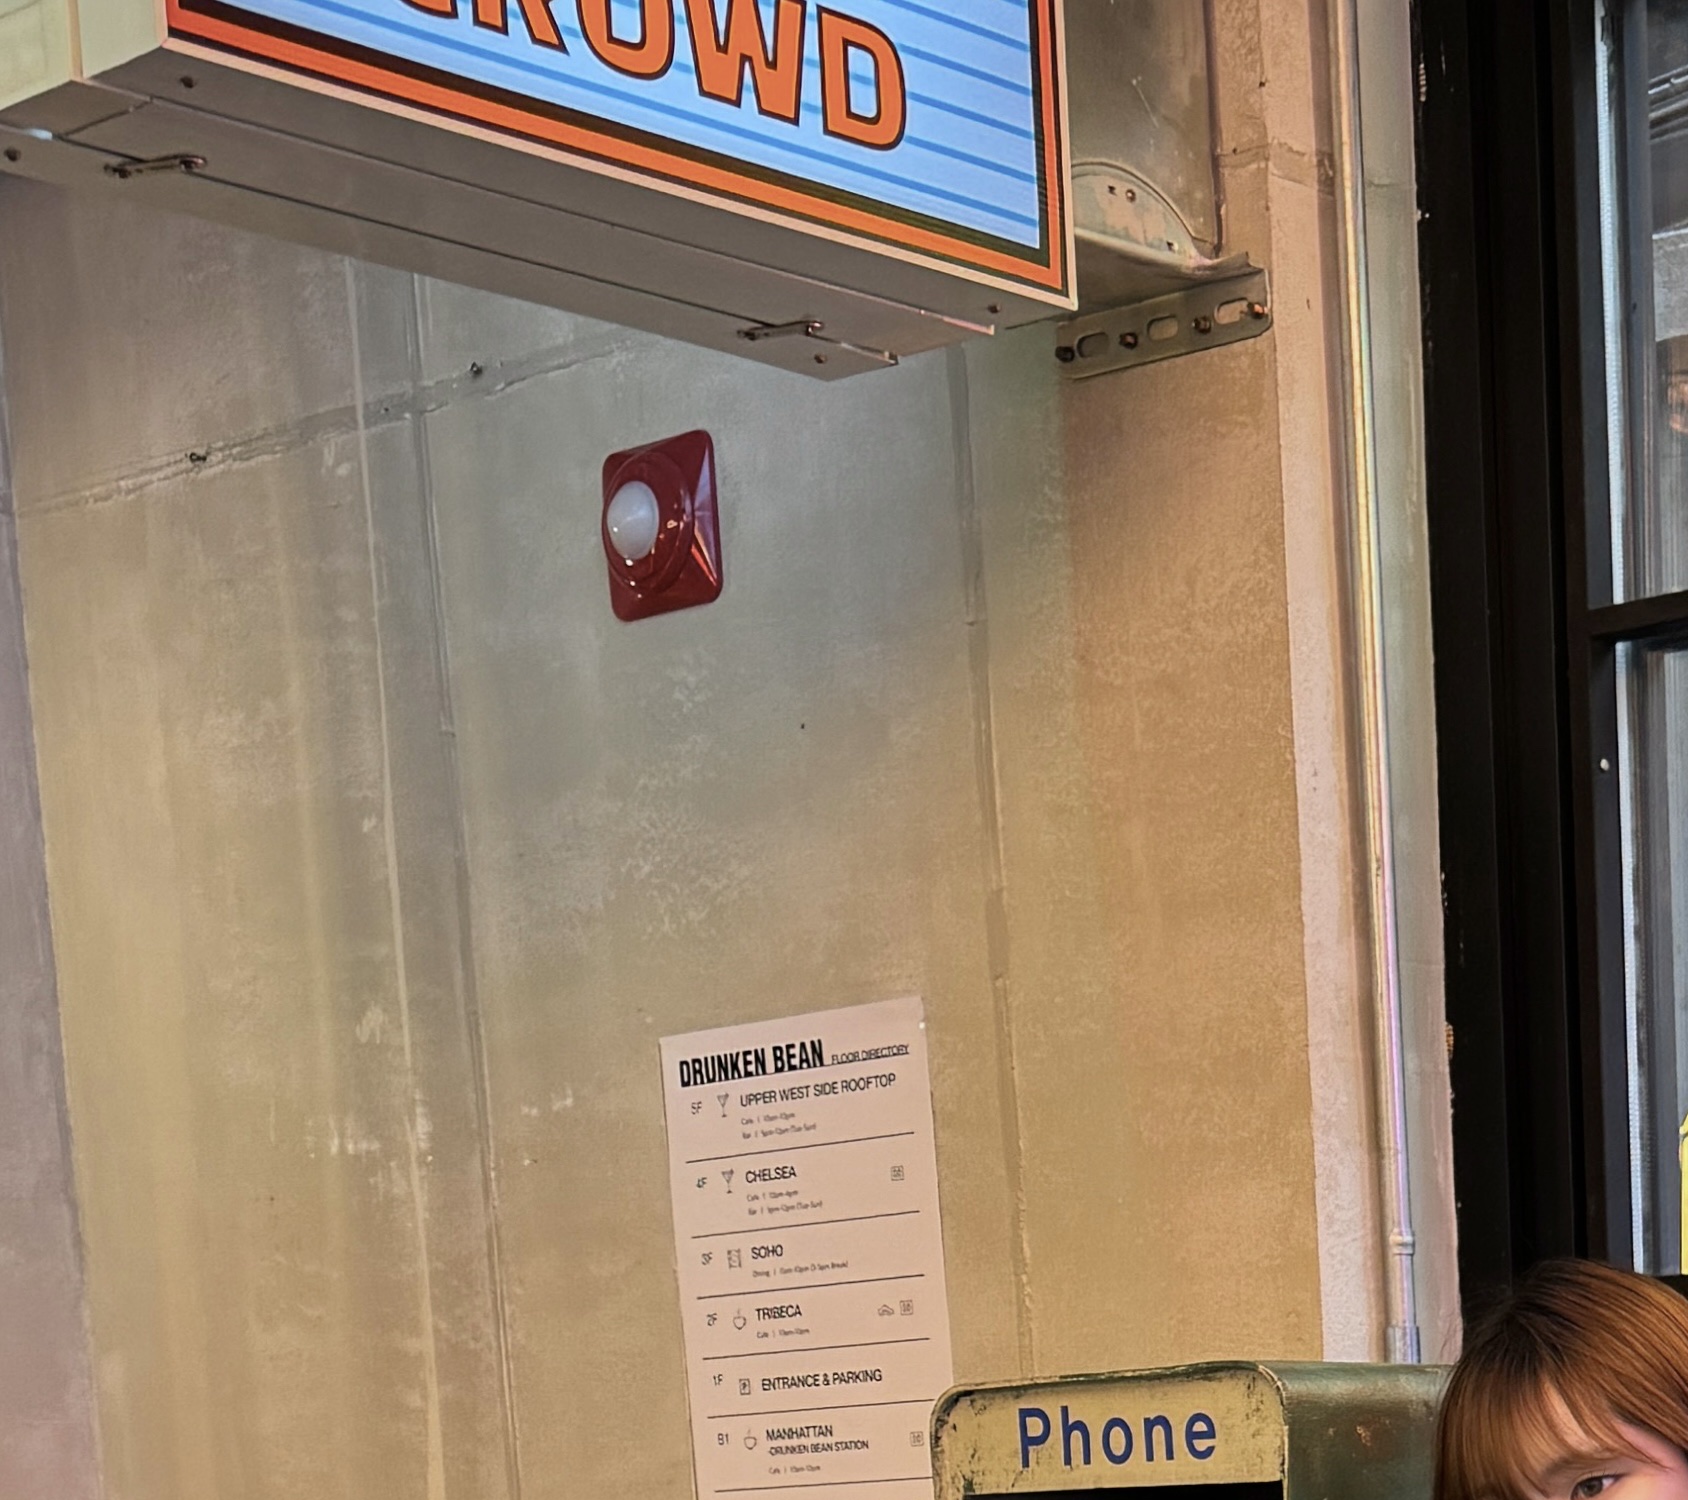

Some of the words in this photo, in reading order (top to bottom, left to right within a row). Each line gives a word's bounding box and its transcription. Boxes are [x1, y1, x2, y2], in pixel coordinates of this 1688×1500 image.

[679, 1047, 768, 1088] DRUNKEN
[772, 1038, 825, 1073] BEAN
[740, 1089, 777, 1108] UPPER
[778, 1085, 811, 1102] WEST
[814, 1081, 839, 1097] SIDE
[841, 1073, 897, 1092] ROOFTOP
[745, 1166, 797, 1184] CHELSEA
[751, 1244, 784, 1260] SOHO
[755, 1304, 802, 1321] TRIBECA
[762, 1373, 820, 1391] ENTRANCE
[822, 1371, 831, 1387] &
[833, 1368, 883, 1385] PARKING
[766, 1425, 833, 1442] MANHATTAN
[1017, 1405, 1218, 1470] Phone
[834, 1439, 870, 1452] STATION
